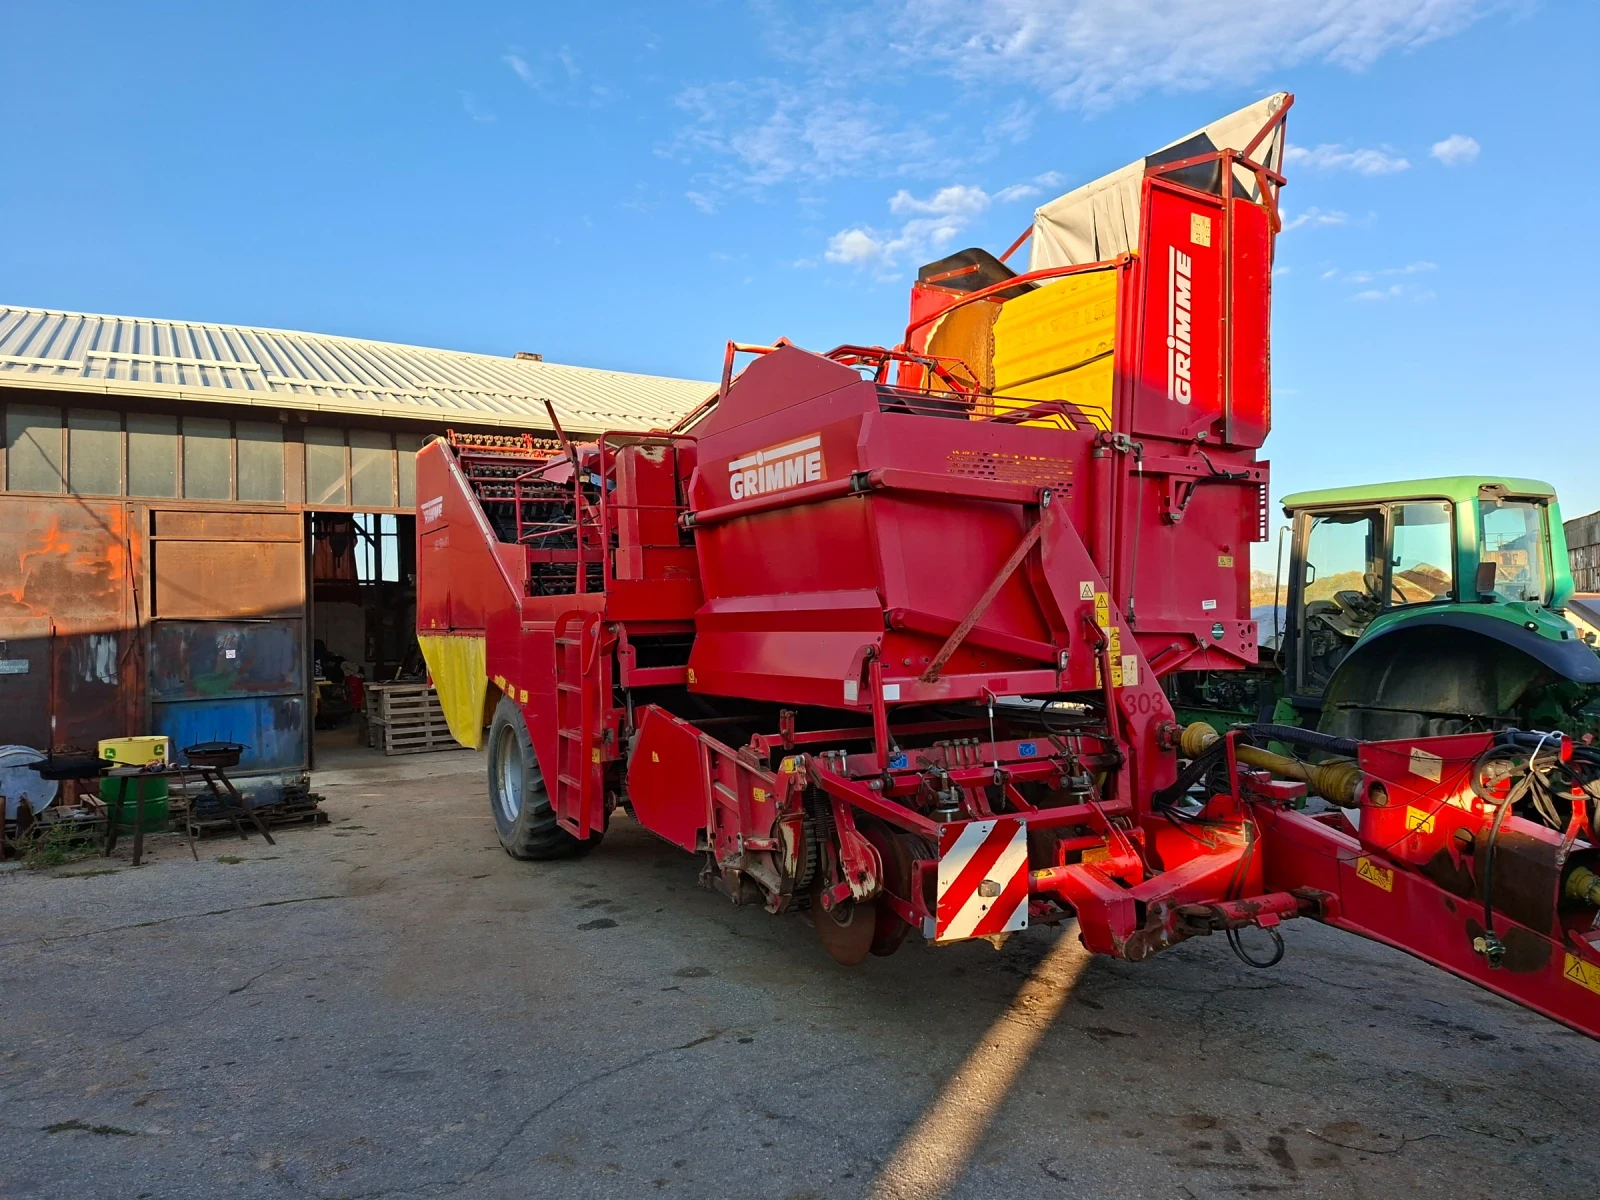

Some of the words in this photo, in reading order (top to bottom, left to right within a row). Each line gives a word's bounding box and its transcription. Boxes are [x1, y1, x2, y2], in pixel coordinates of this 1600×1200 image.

[1167, 249, 1192, 405] GRIMME
[729, 449, 821, 500] GRIMME
[1125, 691, 1164, 716] 303
